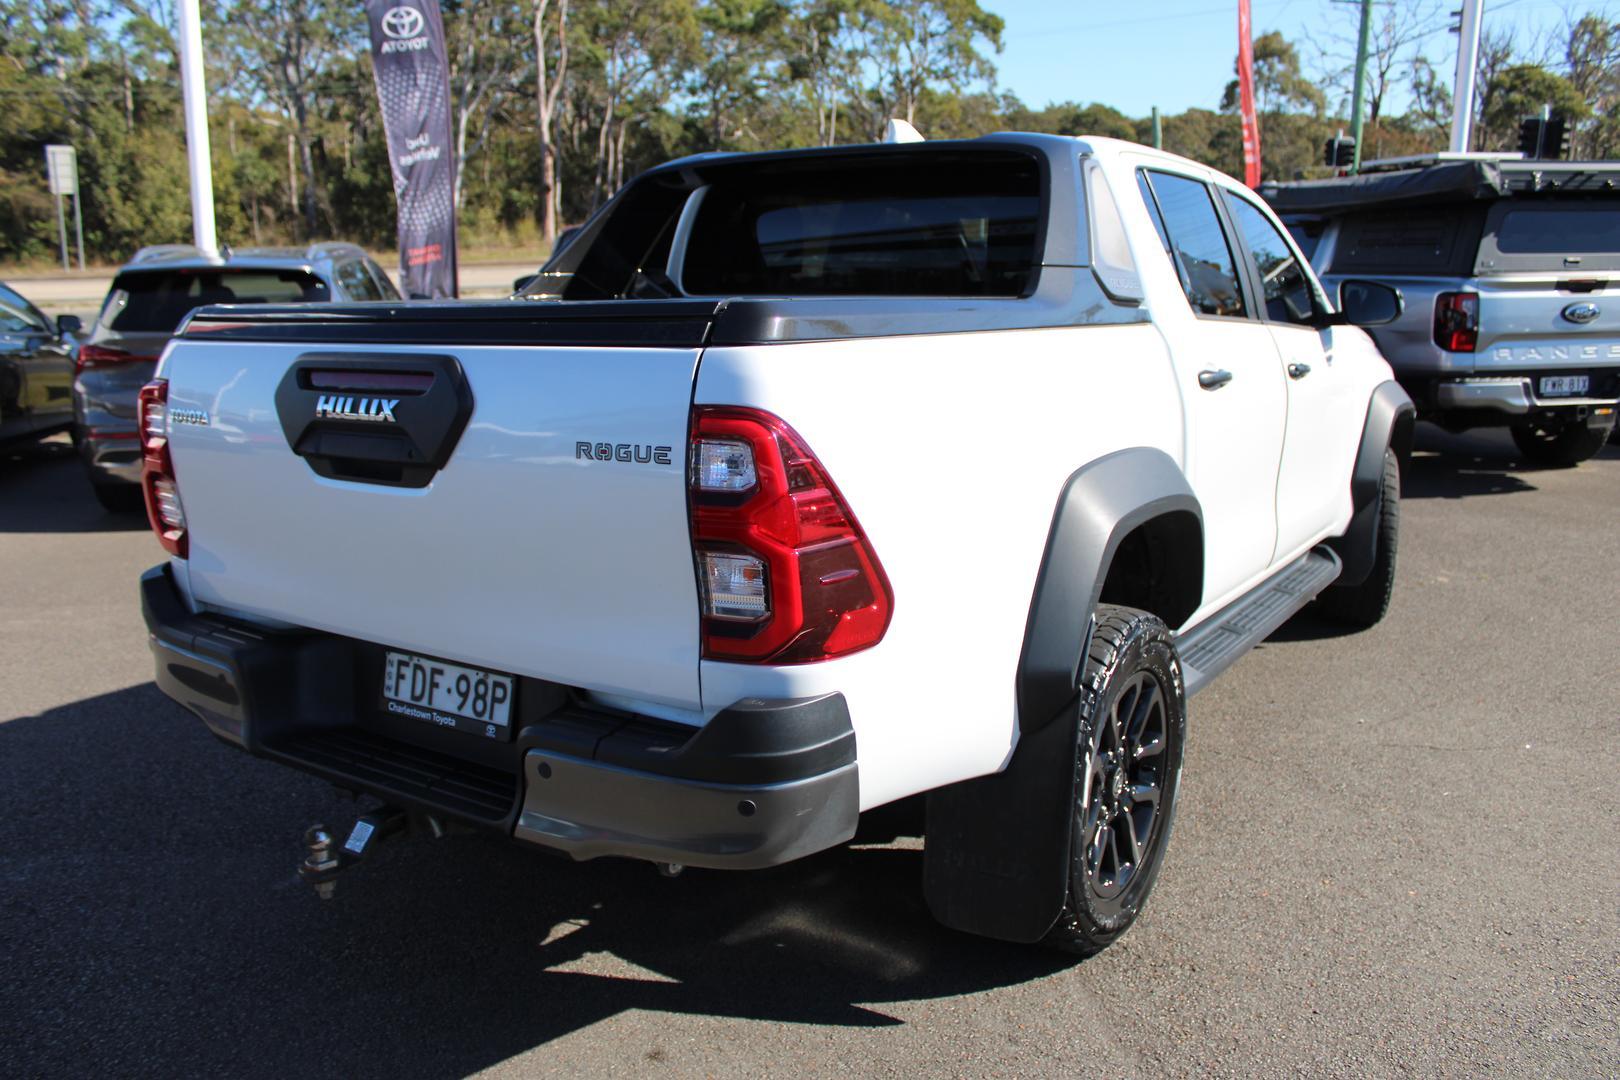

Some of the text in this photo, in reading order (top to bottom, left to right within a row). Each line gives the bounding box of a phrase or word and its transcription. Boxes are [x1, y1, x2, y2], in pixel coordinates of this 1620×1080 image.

[169, 408, 209, 426] TOYOTA
[316, 396, 400, 422] HILUX
[576, 441, 672, 465] ROGUE
[388, 702, 456, 728] Charlestown Toyota
